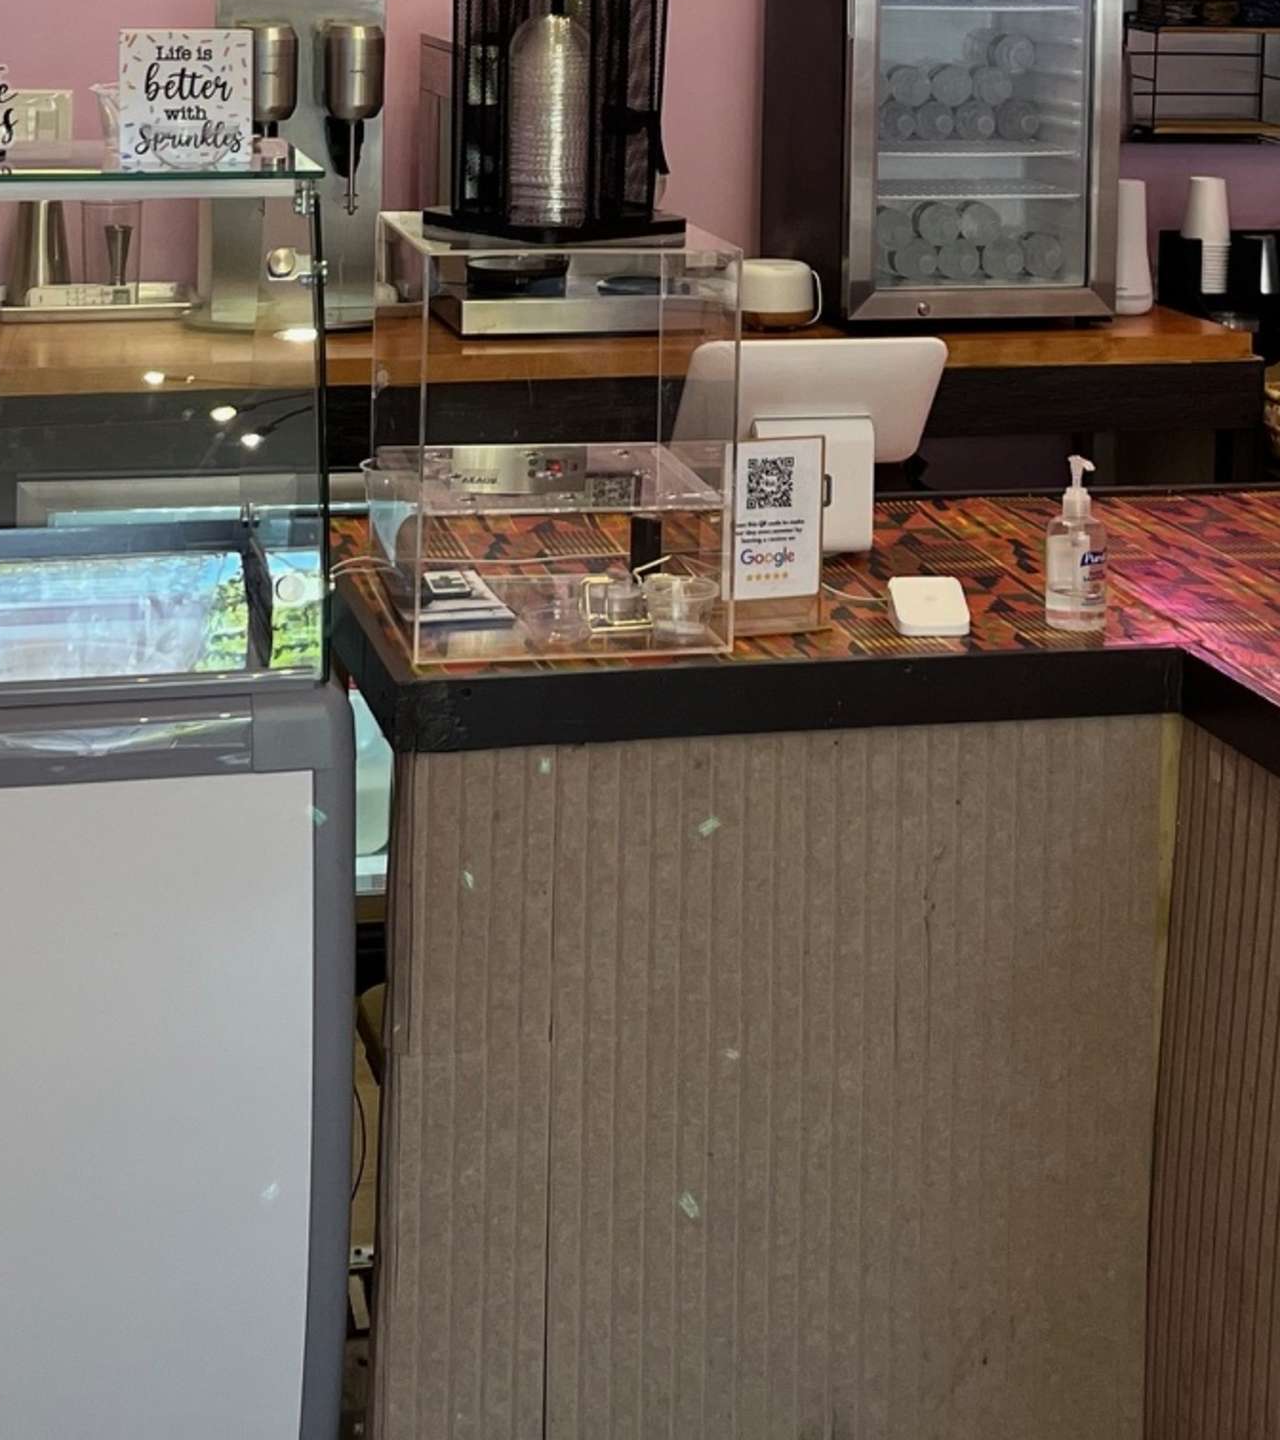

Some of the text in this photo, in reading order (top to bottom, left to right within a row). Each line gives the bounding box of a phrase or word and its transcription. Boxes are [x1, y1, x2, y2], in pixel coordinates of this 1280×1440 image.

[156, 45, 213, 61] Life is
[145, 62, 233, 102] better
[164, 106, 208, 121] with
[134, 120, 244, 155] Sprinkles
[740, 547, 795, 568] Google
